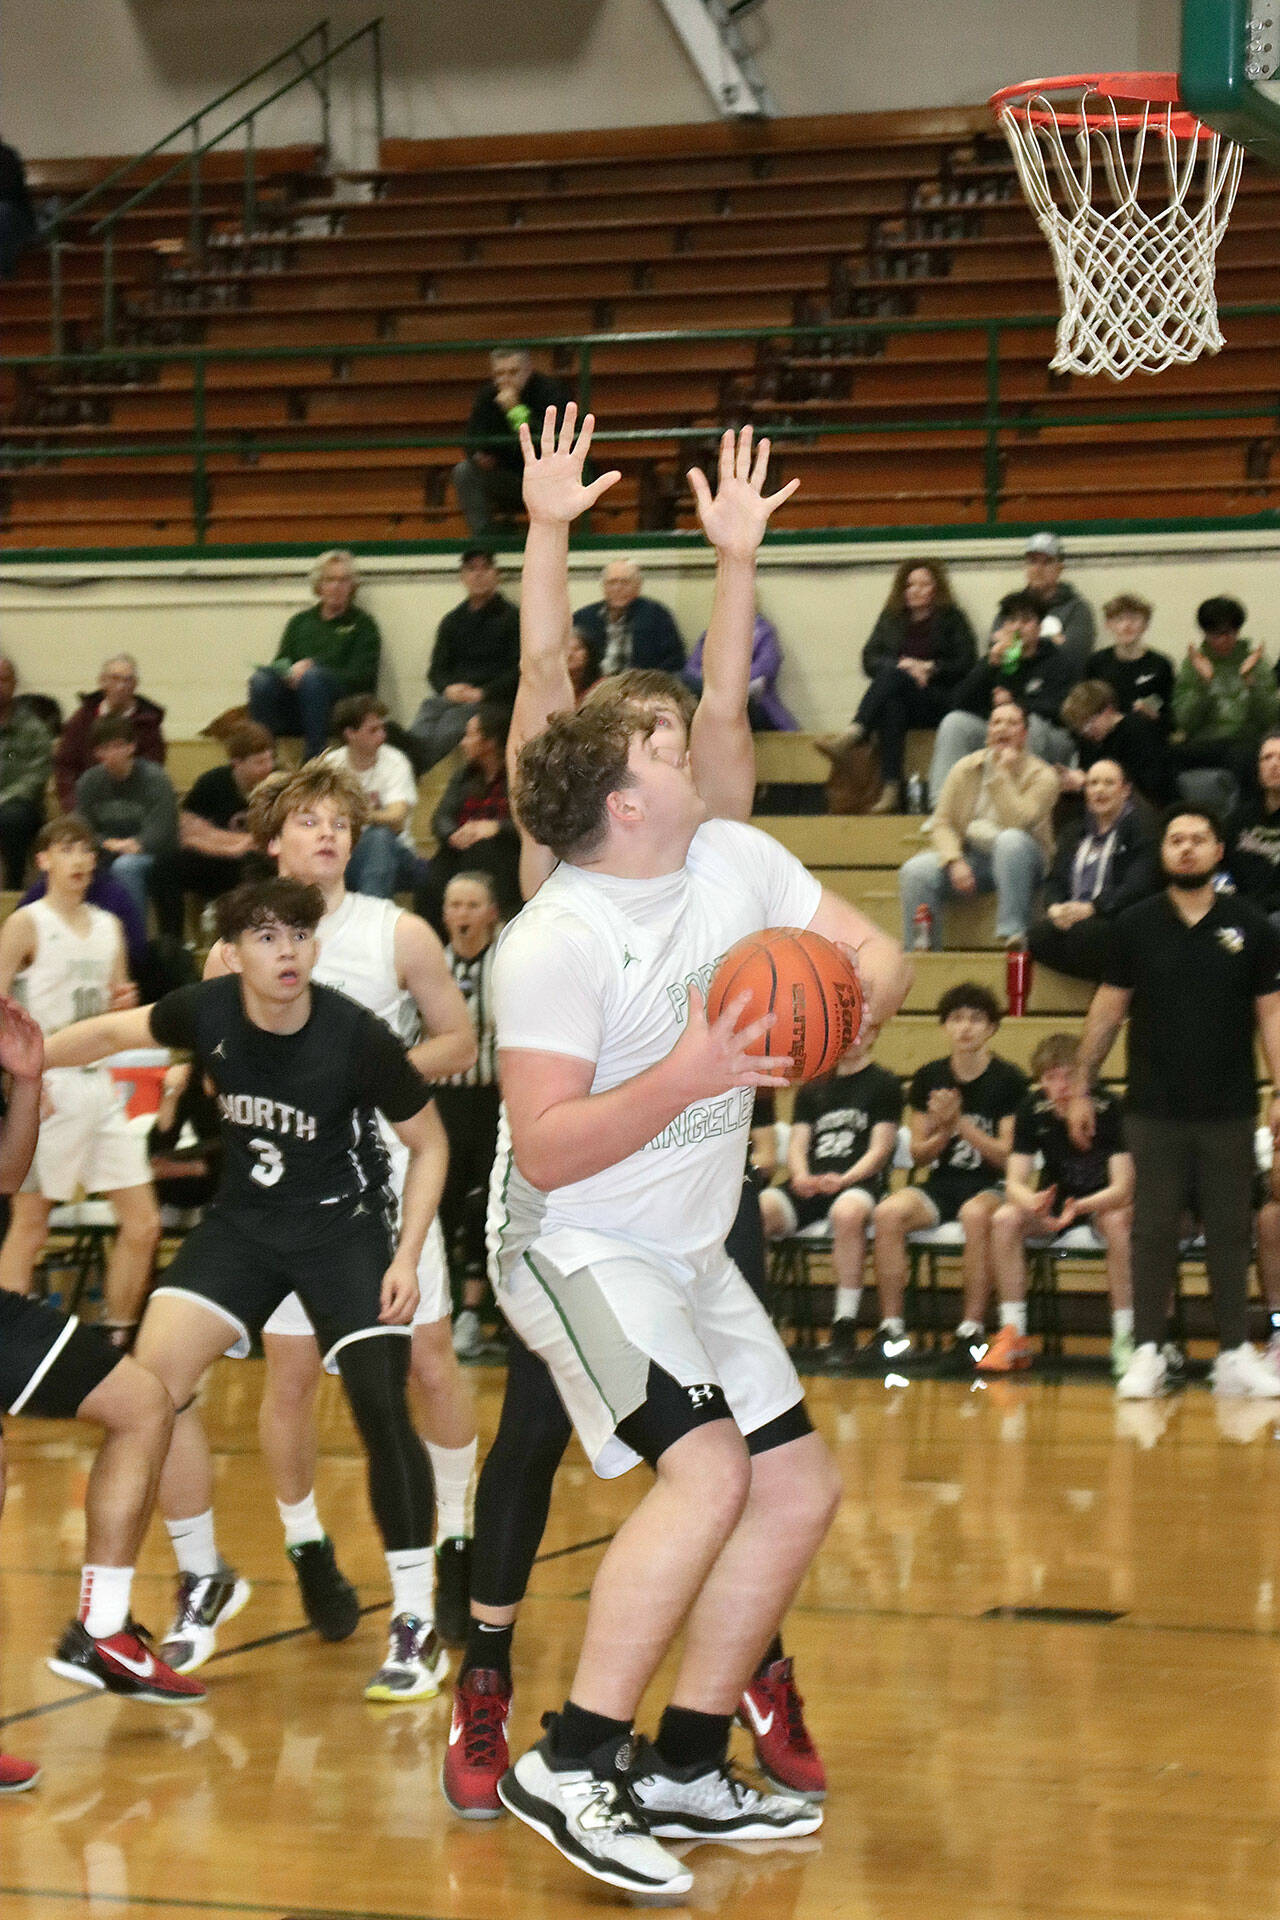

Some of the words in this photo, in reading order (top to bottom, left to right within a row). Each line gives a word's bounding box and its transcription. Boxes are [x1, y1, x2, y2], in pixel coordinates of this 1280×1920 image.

[666, 955, 728, 1024] POR
[218, 1093, 317, 1141] NORTH
[248, 1138, 284, 1187] 3
